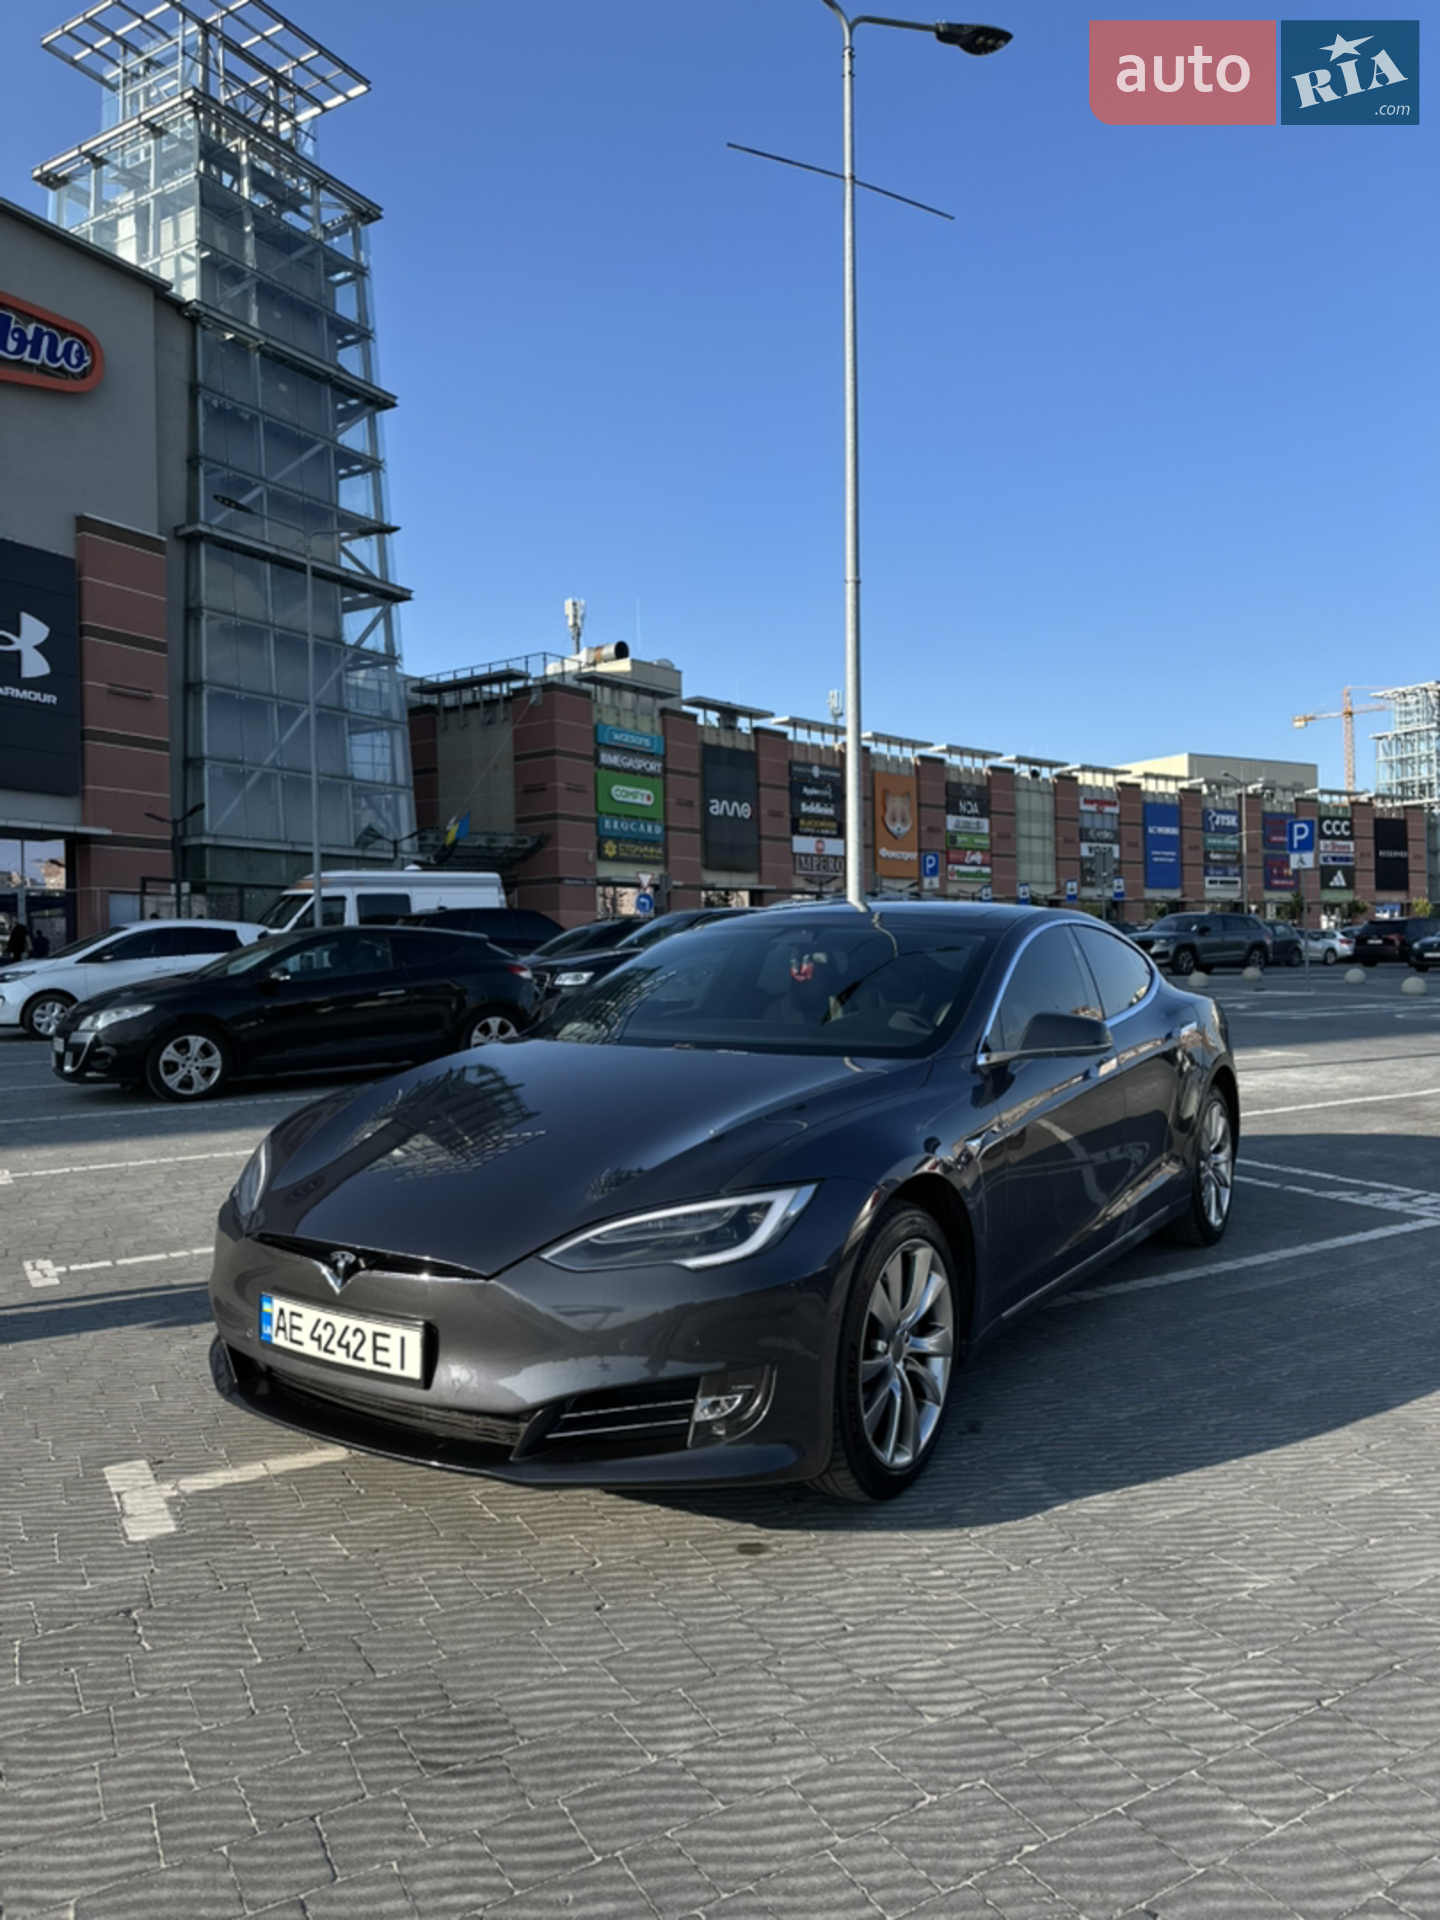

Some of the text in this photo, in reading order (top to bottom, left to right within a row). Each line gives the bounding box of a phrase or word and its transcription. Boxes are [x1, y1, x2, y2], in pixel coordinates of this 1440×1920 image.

[614, 788, 645, 802] COMFY
[604, 819, 662, 835] BROCARD
[1214, 813, 1238, 826] JYSK
[1293, 823, 1309, 849] P
[1322, 820, 1350, 836] CCC
[1379, 850, 1408, 858] RESERVED
[795, 855, 844, 873] IMPERO
[926, 855, 936, 874] P
